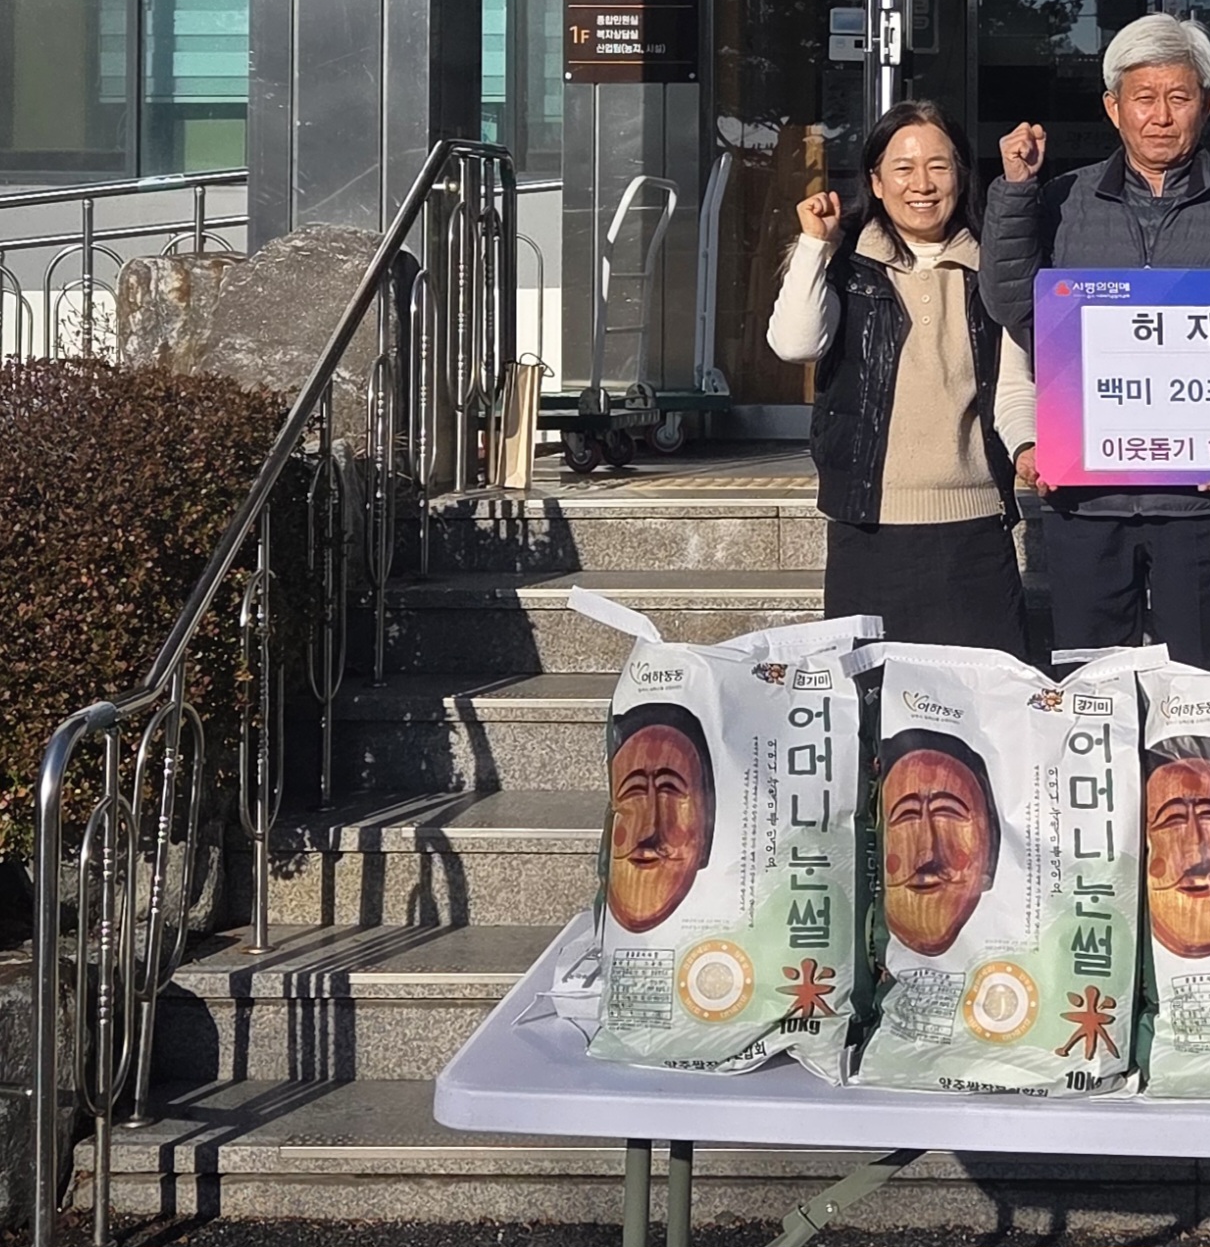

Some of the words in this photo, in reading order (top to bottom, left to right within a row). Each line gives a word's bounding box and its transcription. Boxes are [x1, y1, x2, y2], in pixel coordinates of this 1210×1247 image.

[569, 25, 591, 44] 1F
[597, 29, 639, 39] 복지상담실
[1072, 281, 1131, 295] 사랑의열매
[1097, 377, 1152, 406] 백미
[1102, 438, 1195, 462] 이웃돕기
[795, 673, 830, 687] 경기미
[1076, 699, 1109, 712] 경기미
